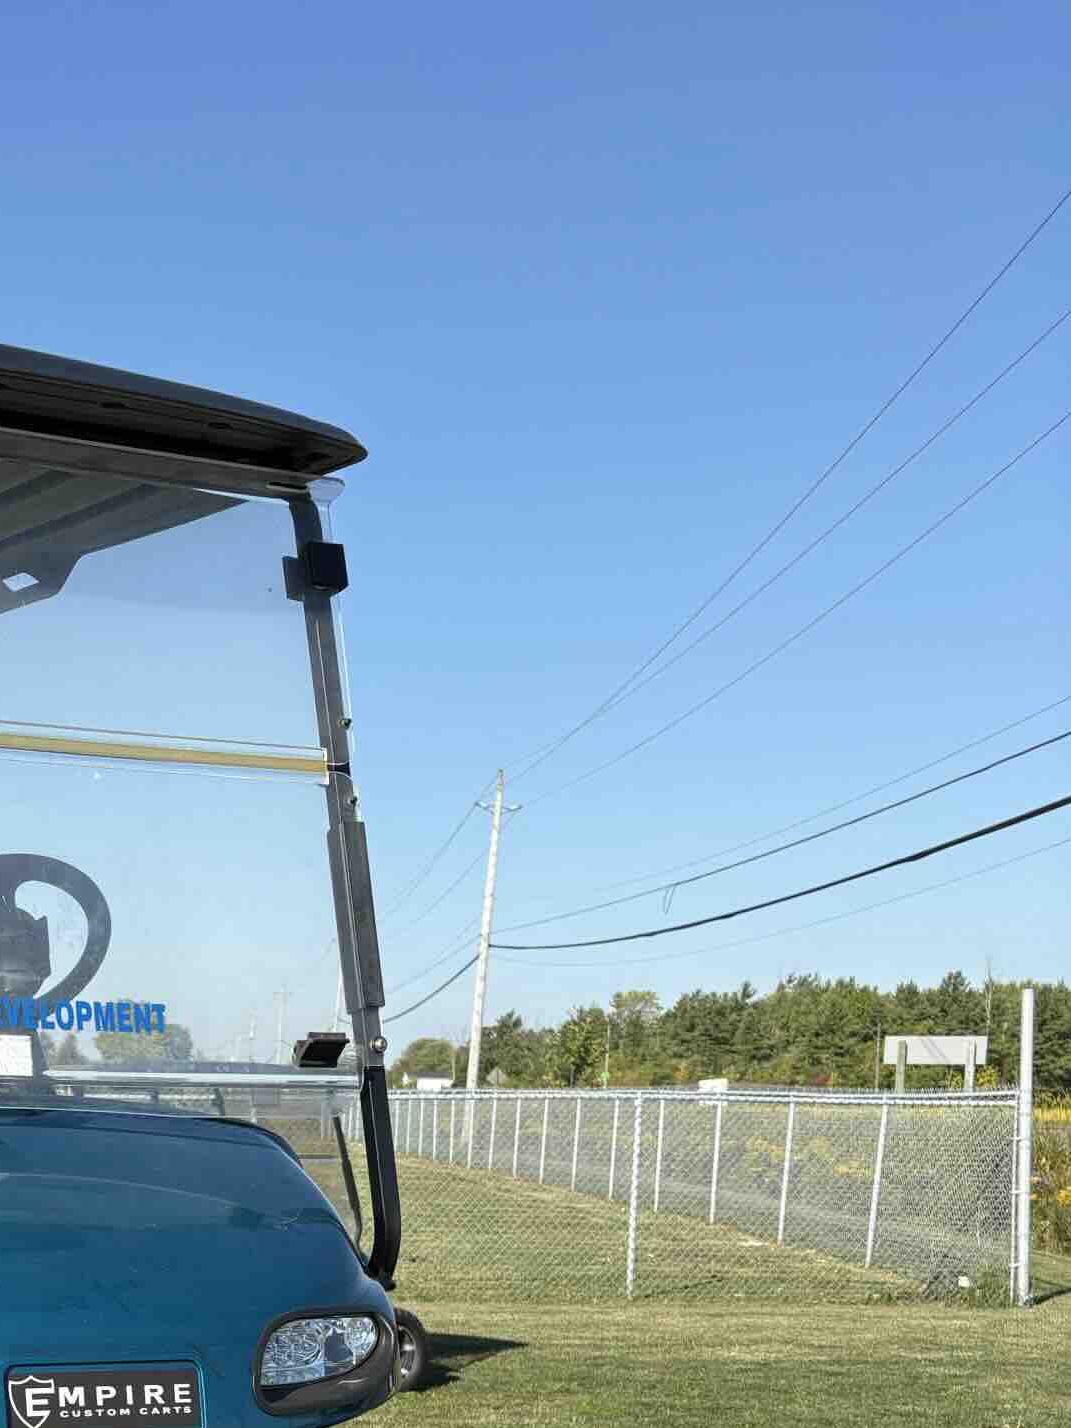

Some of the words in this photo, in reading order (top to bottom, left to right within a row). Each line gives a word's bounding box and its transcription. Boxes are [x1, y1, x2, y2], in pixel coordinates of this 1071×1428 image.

[25, 1383, 192, 1417] EMPIRE
[59, 1408, 130, 1418] CUSTOM
[139, 1406, 192, 1416] CARTS
